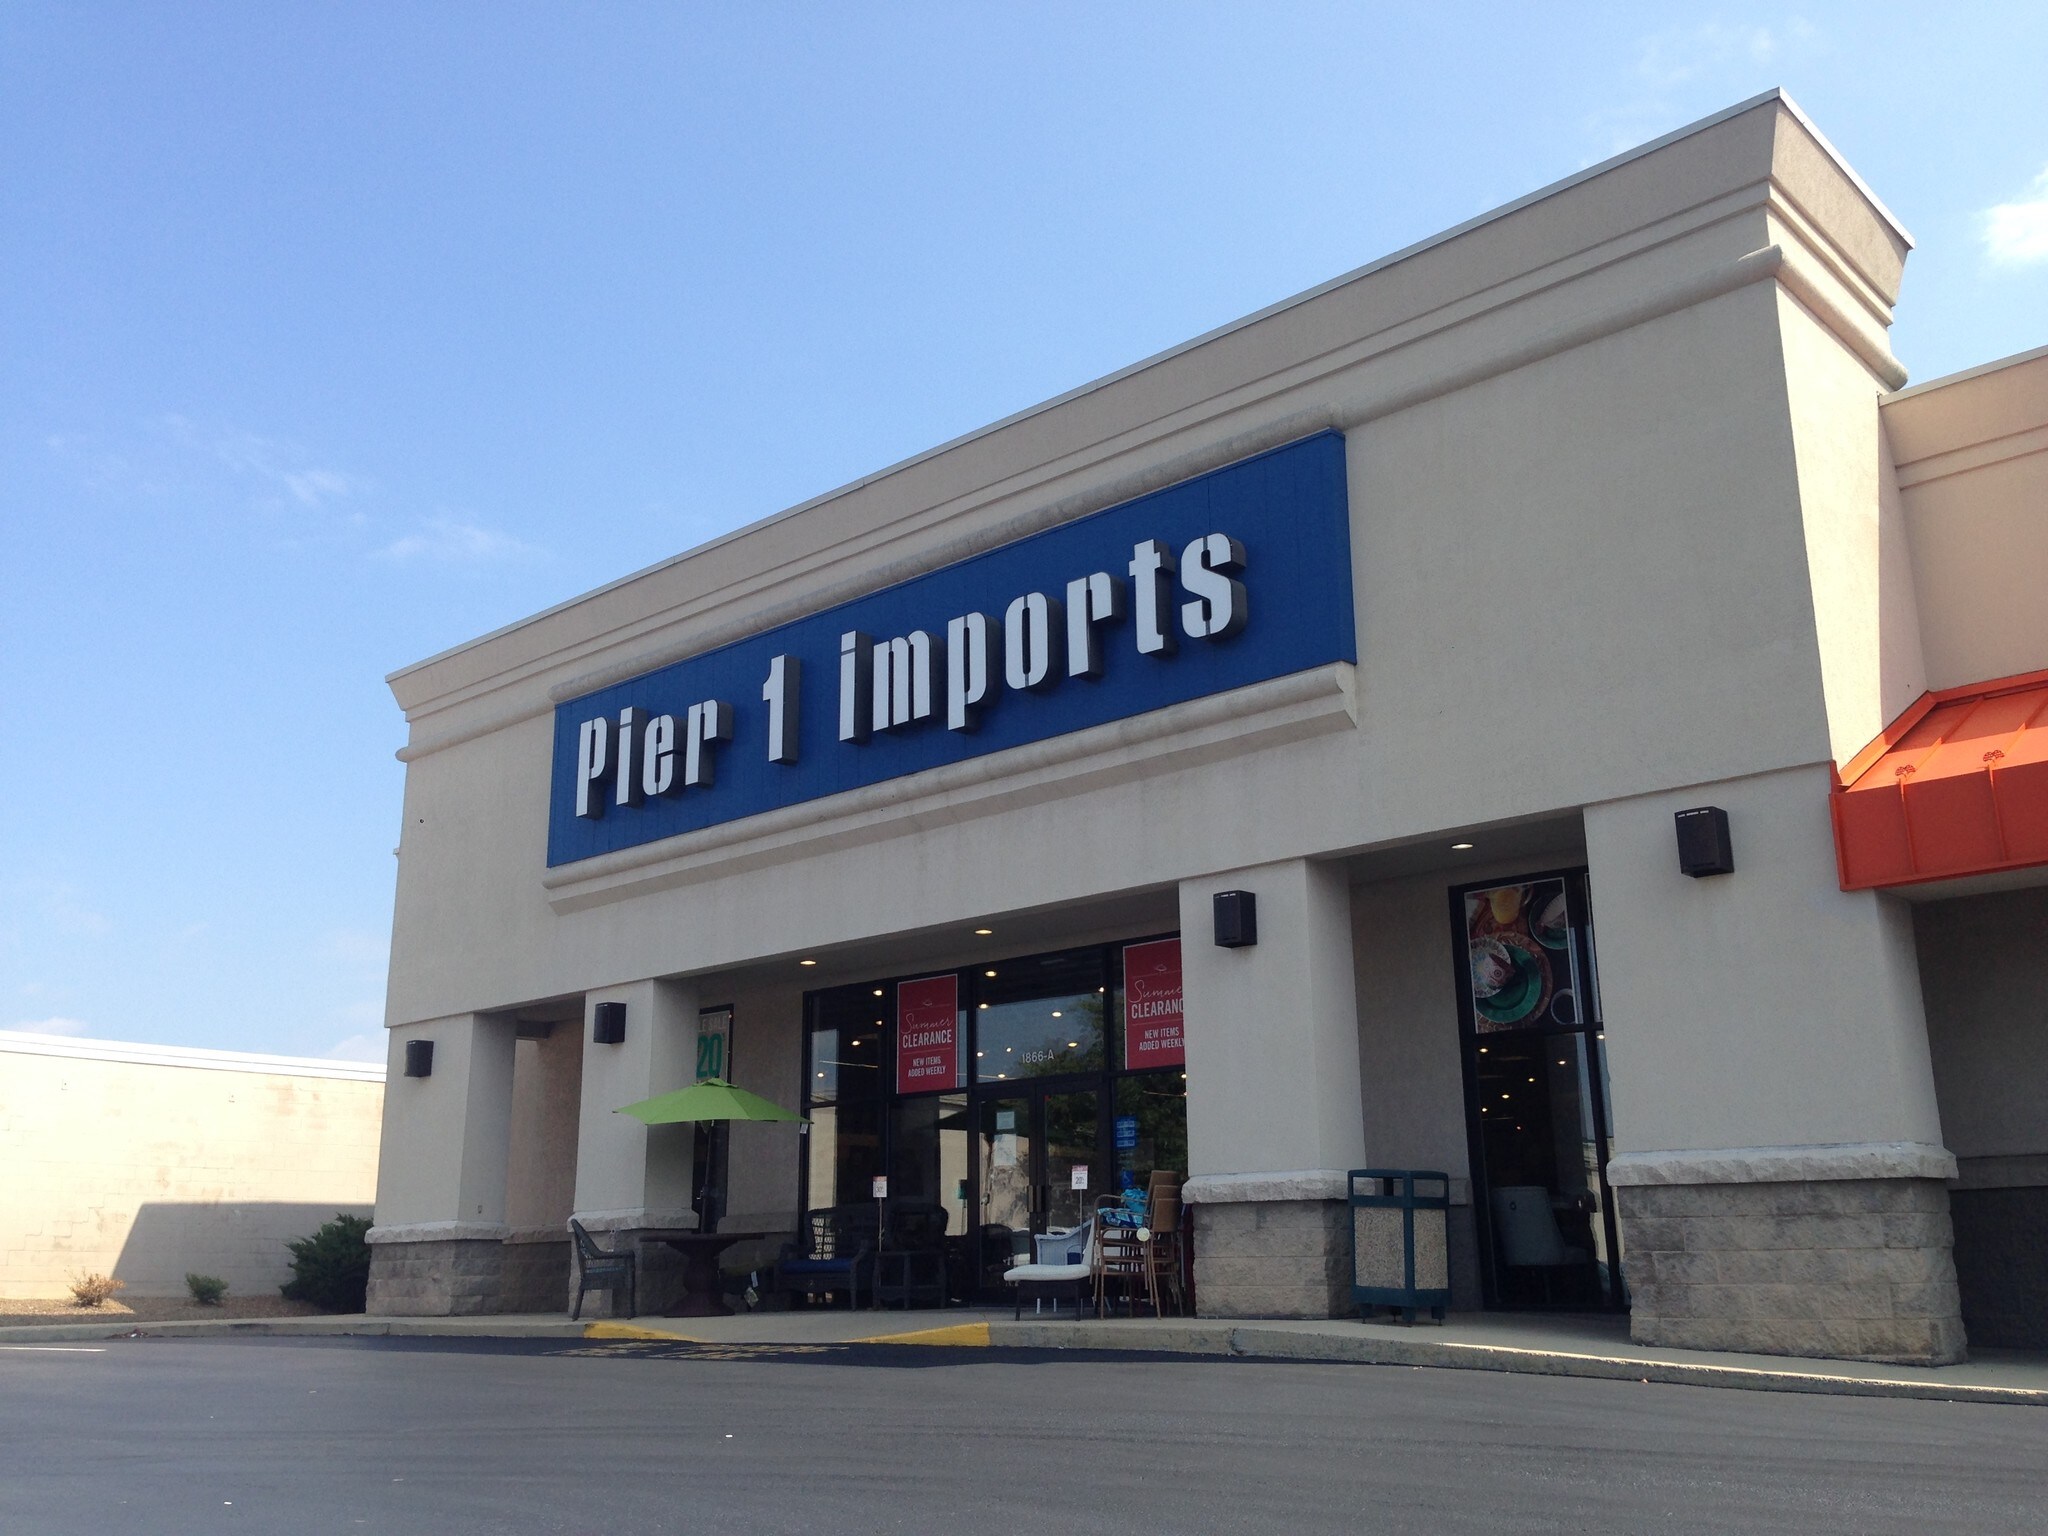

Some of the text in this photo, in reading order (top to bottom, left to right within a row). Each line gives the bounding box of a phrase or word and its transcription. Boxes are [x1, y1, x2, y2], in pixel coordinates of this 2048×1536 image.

[575, 531, 1248, 819] Pier 1 imports
[1128, 979, 1183, 1003] Summe
[1131, 998, 1184, 1019] CLEARANC
[901, 1012, 953, 1034] Summer
[902, 1029, 952, 1048] CLEARANCE
[1145, 1027, 1179, 1039] NEW ITEMS
[1139, 1041, 1159, 1051] ADDED
[913, 1056, 941, 1067] NEW ITEMS
[1022, 1049, 1055, 1064] 1866-A
[908, 1066, 946, 1077] ADDED WEEKLY
